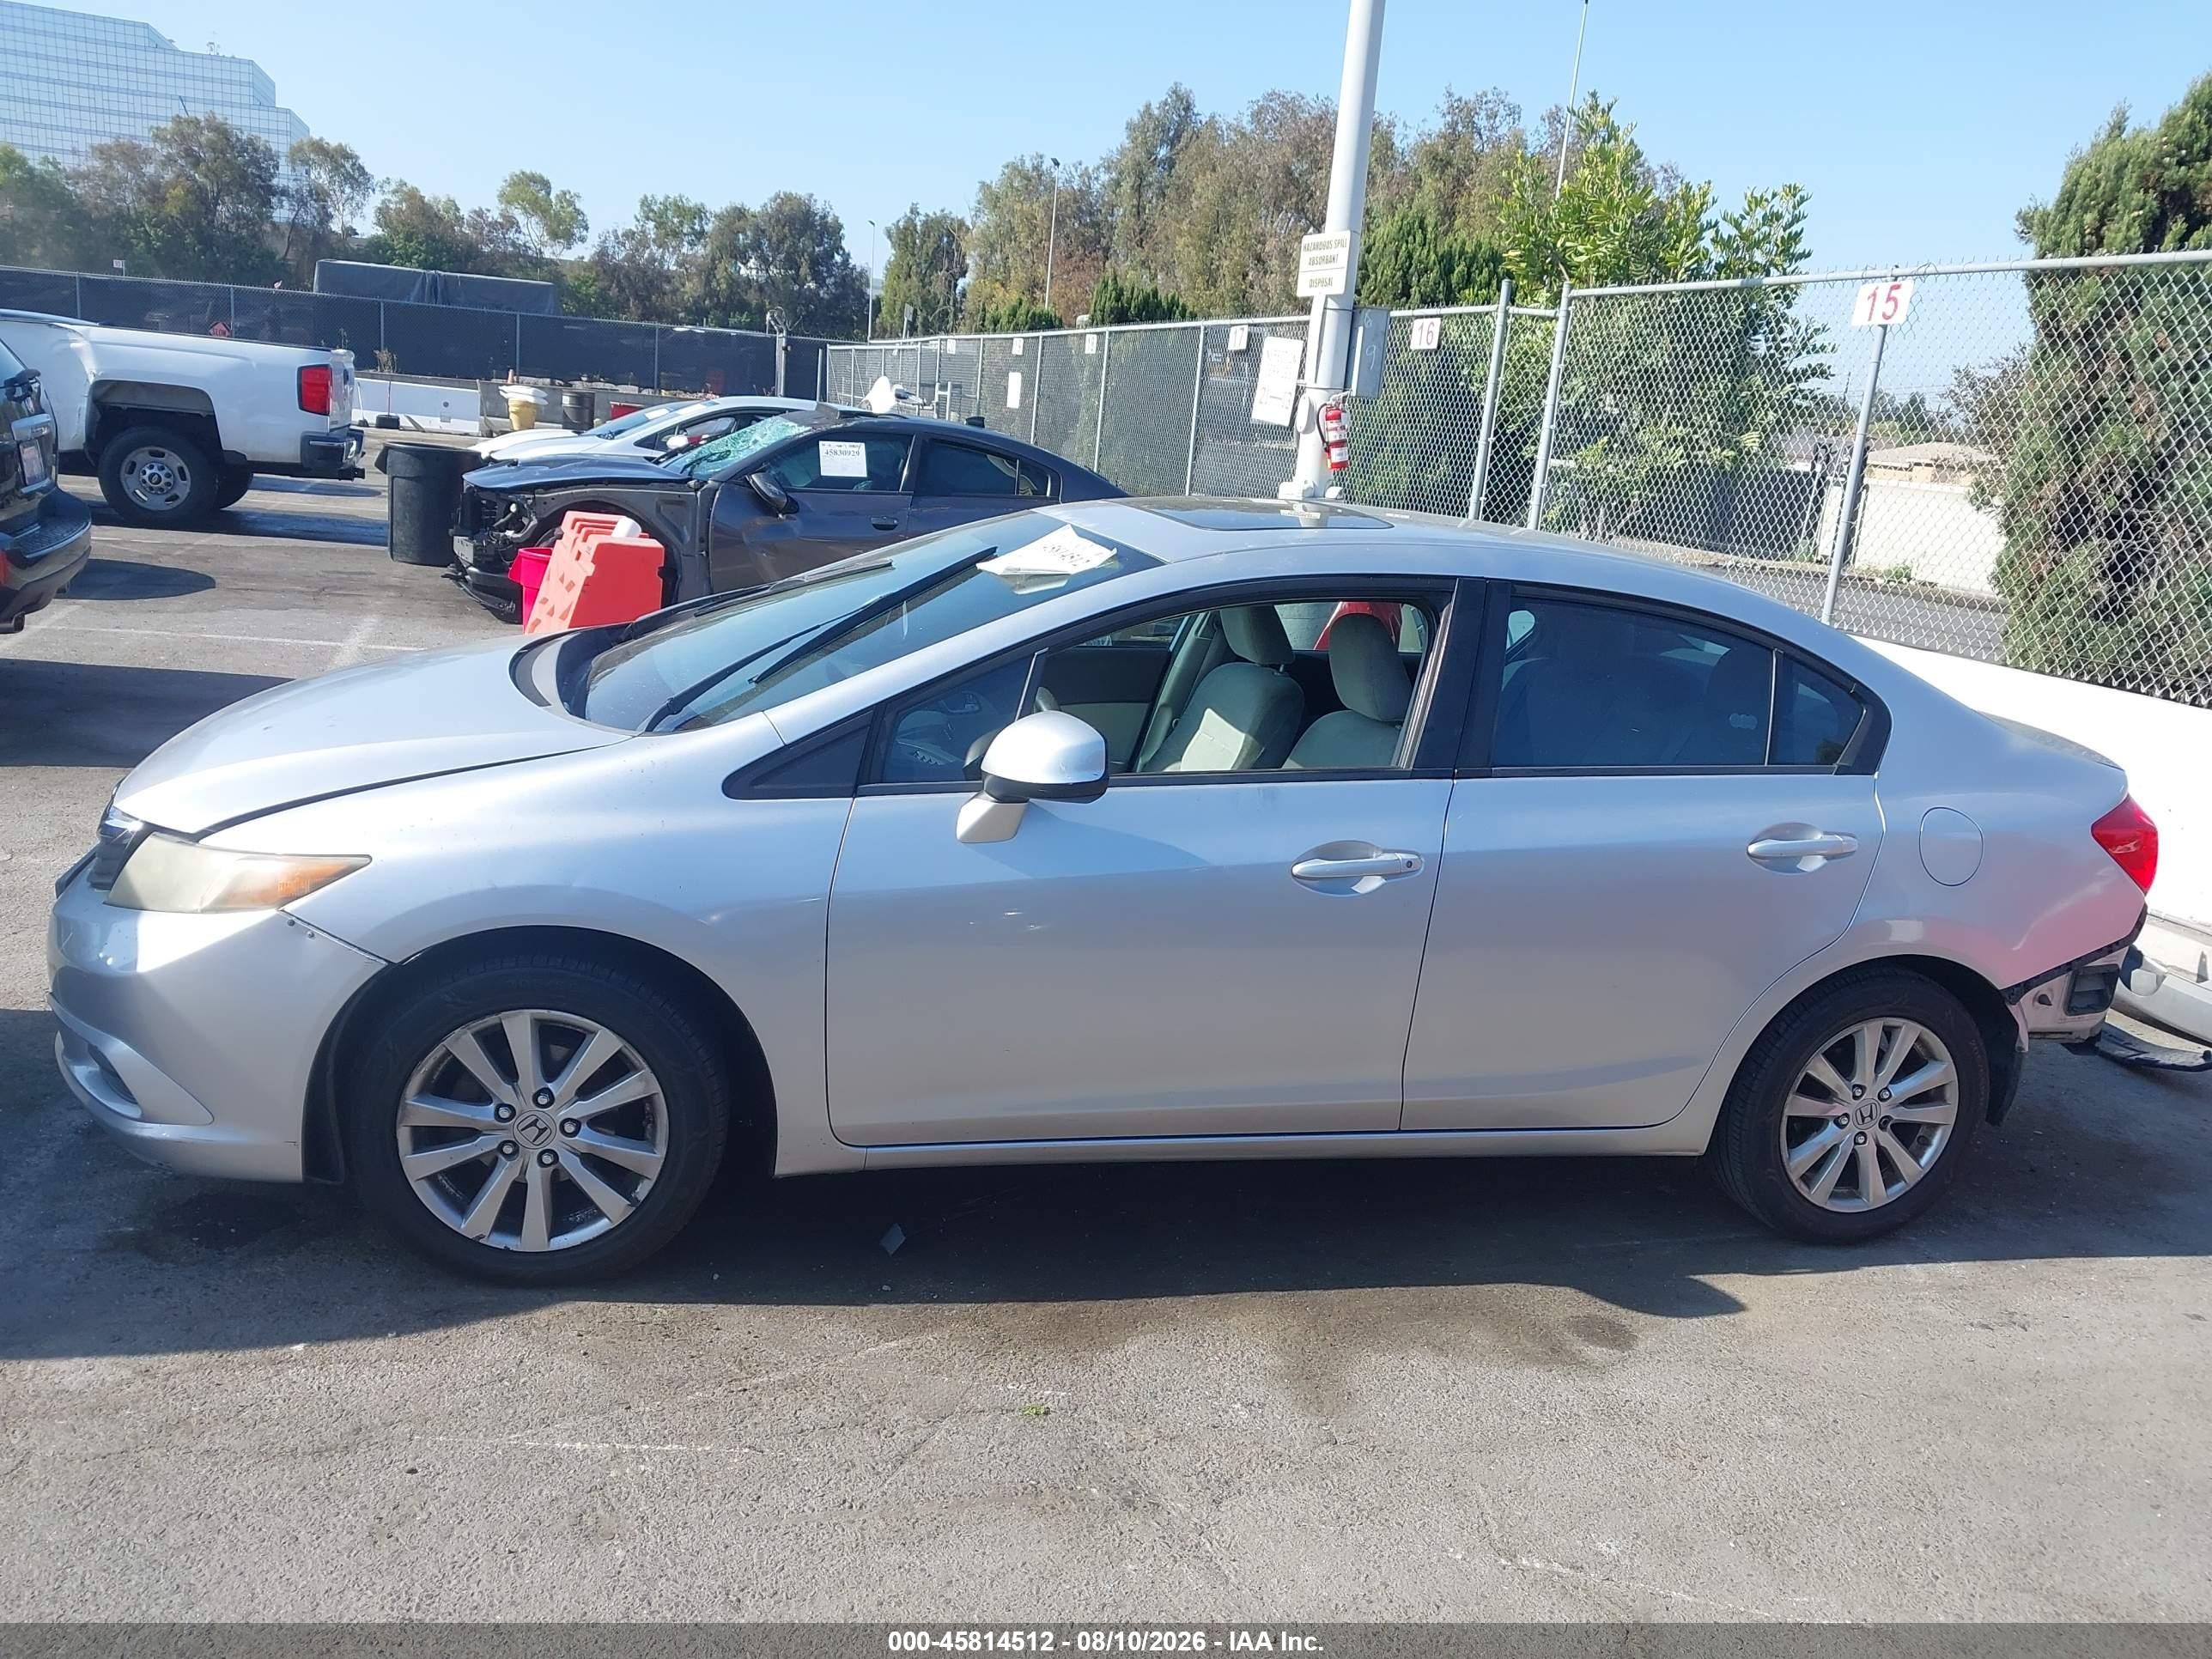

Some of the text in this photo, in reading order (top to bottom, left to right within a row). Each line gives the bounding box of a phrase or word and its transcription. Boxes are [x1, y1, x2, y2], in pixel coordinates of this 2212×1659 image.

[1303, 238, 1347, 252] HAZARDOUS SPILL
[1308, 253, 1339, 266] ABSORBANT
[1309, 276, 1334, 289] DISPOSAL
[1867, 283, 1902, 322] 15
[1233, 326, 1245, 347] 17
[1418, 320, 1435, 346] 16
[824, 448, 860, 457] 45830929
